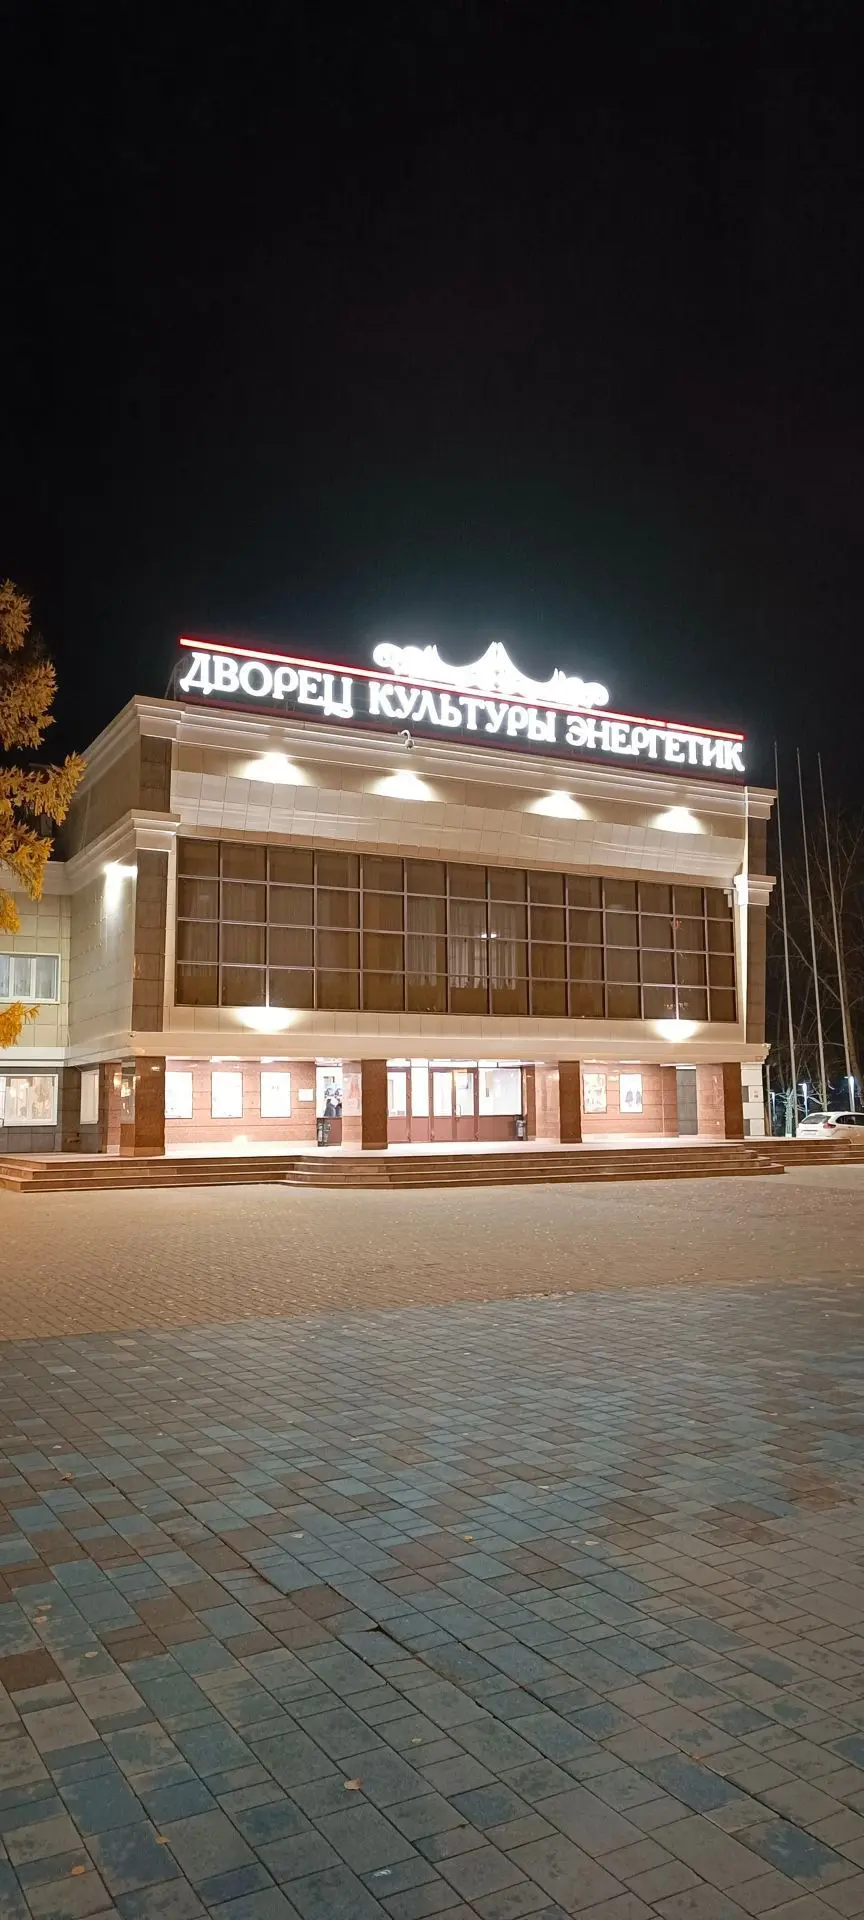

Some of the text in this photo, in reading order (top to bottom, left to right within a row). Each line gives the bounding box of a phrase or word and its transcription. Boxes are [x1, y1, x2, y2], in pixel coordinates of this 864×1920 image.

[179, 652, 745, 771] ДВОРЕЦ КУЛЬТУРЫ ЭНЕРГЕТИК
